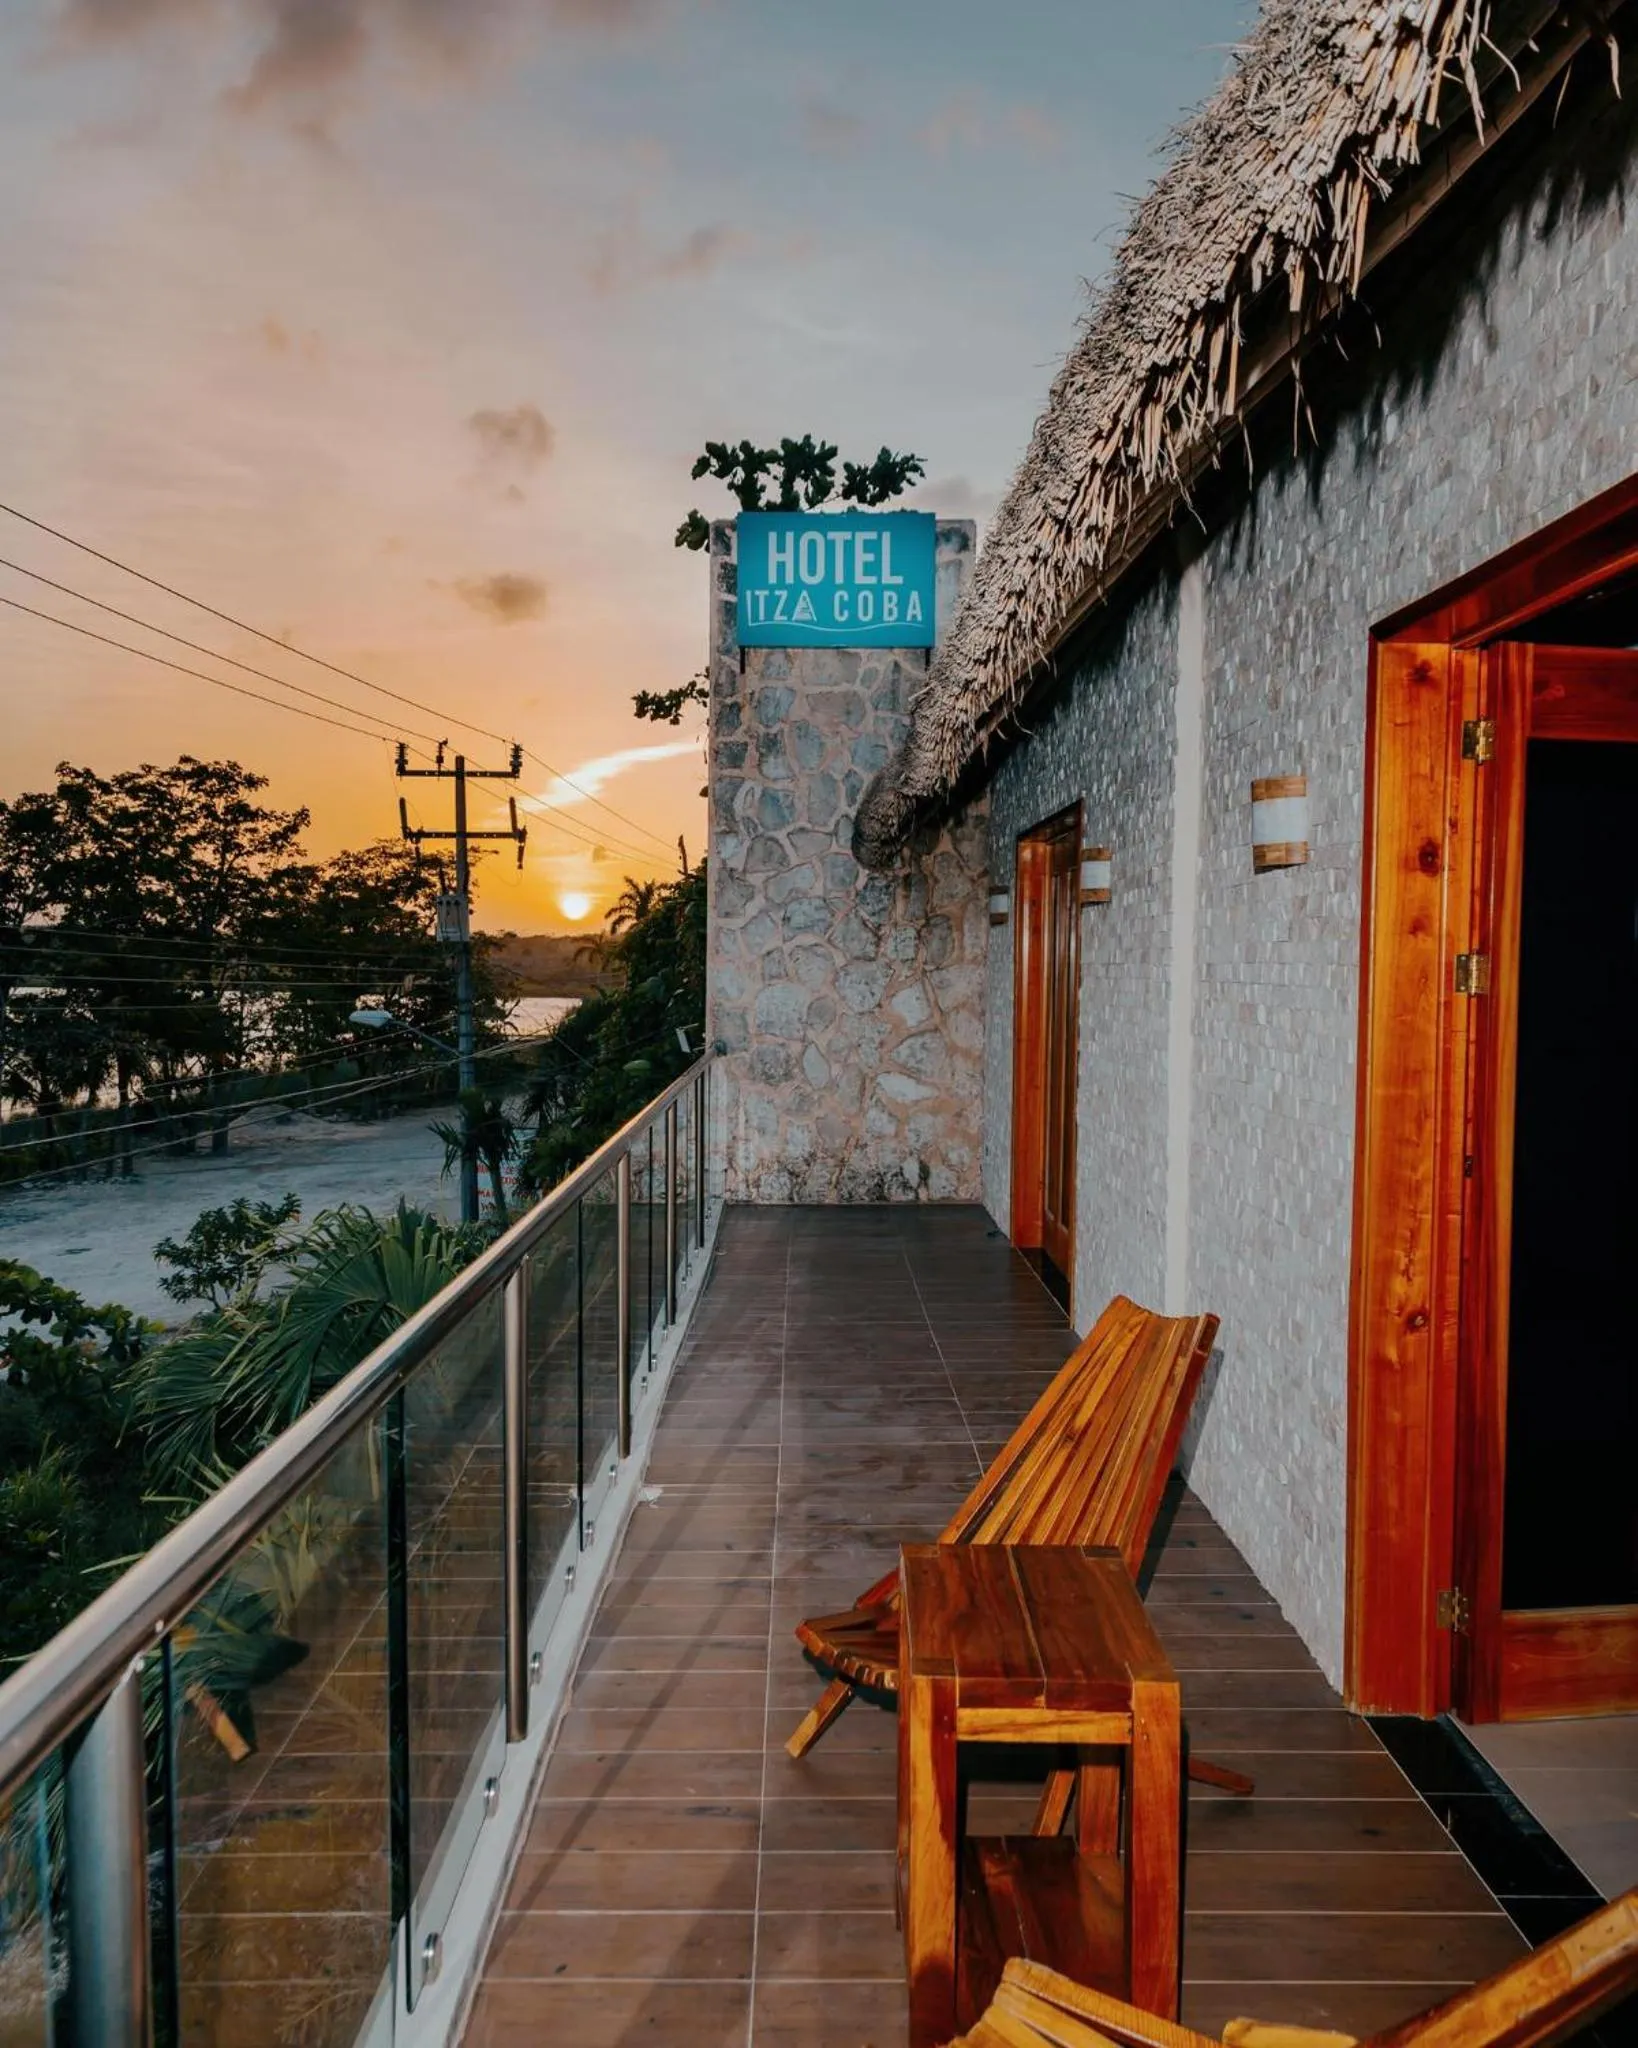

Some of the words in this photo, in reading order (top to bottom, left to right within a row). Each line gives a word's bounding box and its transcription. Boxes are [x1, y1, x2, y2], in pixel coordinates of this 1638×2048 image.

[767, 530, 904, 585] HOTEL
[745, 589, 817, 624] ITZA
[833, 589, 923, 622] COBA
